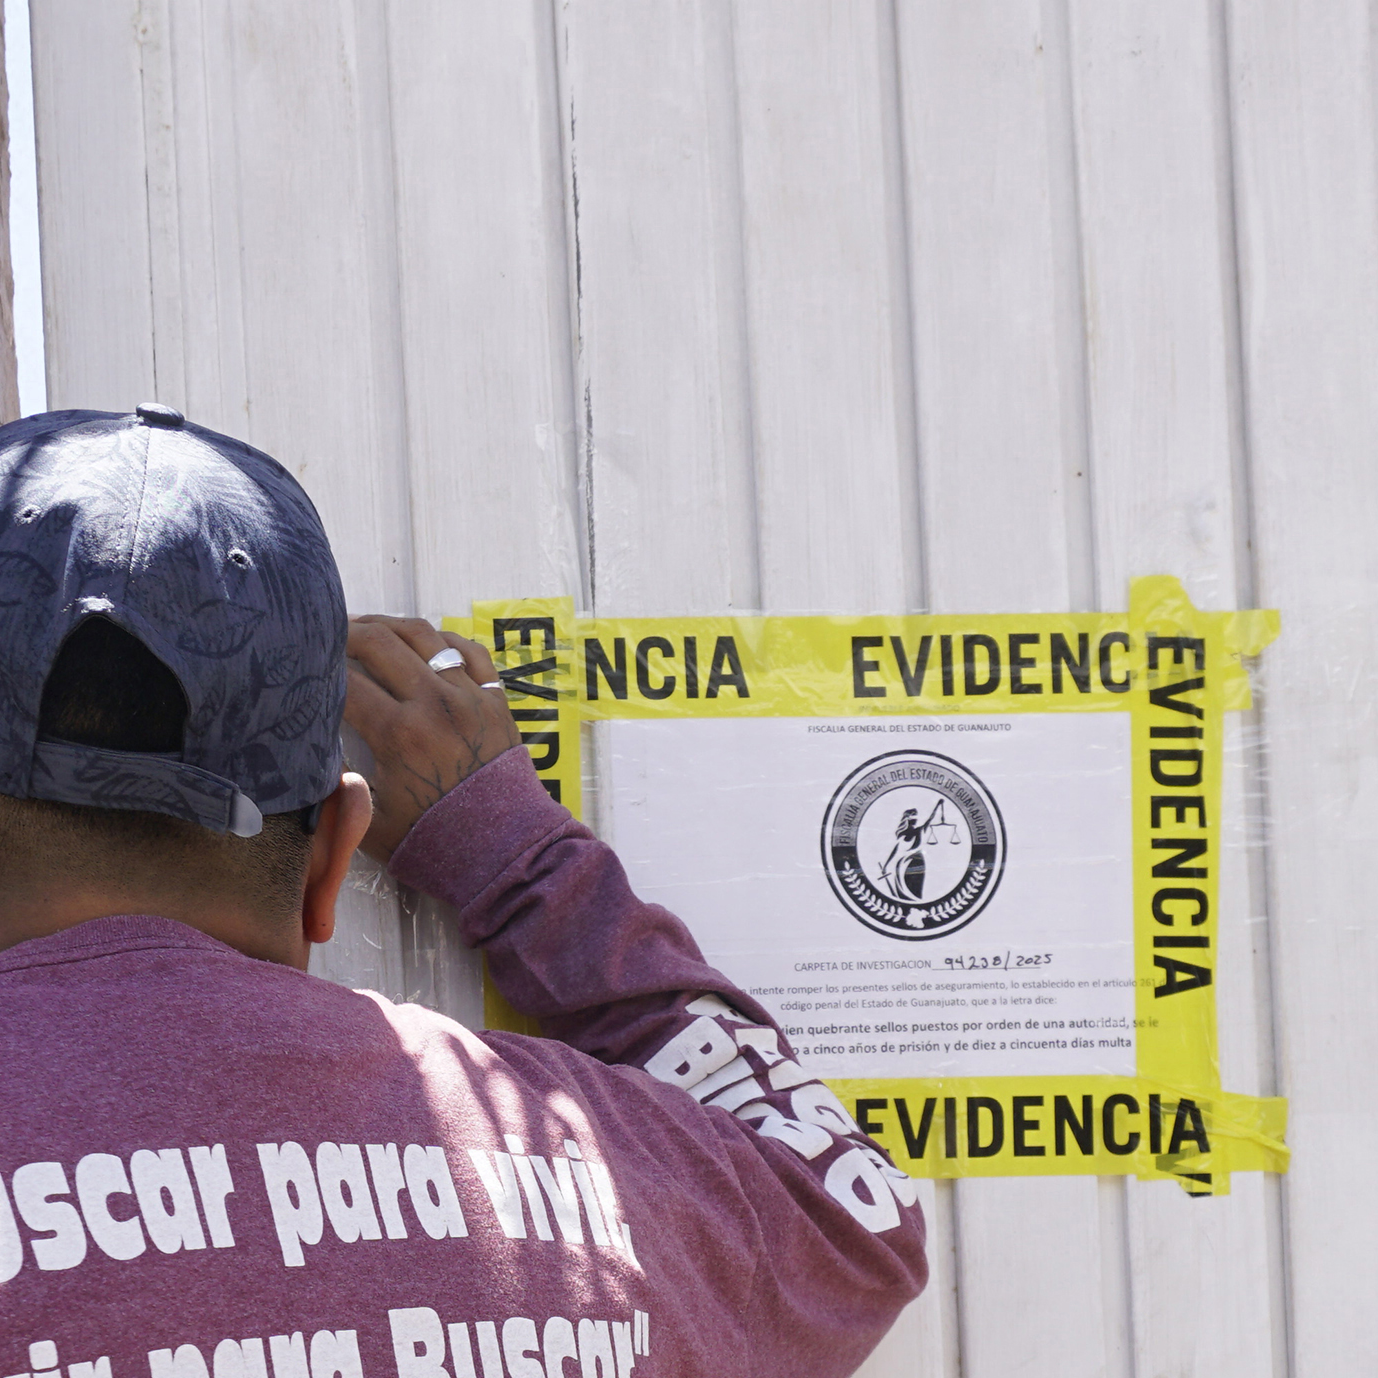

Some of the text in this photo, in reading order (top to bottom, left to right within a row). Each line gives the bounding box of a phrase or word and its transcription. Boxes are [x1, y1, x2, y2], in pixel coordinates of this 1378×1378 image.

[584, 630, 1132, 700] NCIA EVIDENC
[808, 723, 1012, 734] FISCALIA GENERAL DEL ESTADO DE GUANAJUTO
[839, 804, 859, 845] FISCALIA
[856, 775, 891, 809] GENERAL
[890, 768, 909, 785] DEL
[910, 768, 944, 785] ESTADO
[945, 778, 959, 793] DE
[1147, 634, 1213, 999] EVIDENCIA
[794, 960, 932, 972] CARPETA DE INVESTIGACION
[944, 950, 1053, 971] 94238/2025
[749, 986, 785, 995] intente
[787, 986, 823, 997] romper
[825, 984, 840, 993] los
[842, 984, 889, 996] presentes
[891, 982, 918, 992] sellos
[920, 982, 933, 992] de
[935, 979, 1009, 993] aseguramiento,
[1011, 980, 1020, 990] lo
[1022, 979, 1075, 990] establecido
[1078, 979, 1089, 989] en
[1092, 979, 1101, 988] el
[780, 995, 1057, 1012] código penal del Estado de Guanajuato, que la letra dice:
[782, 1025, 804, 1036] ien
[807, 1023, 871, 1039] quebrante
[874, 1021, 908, 1034] sellos
[911, 1021, 959, 1037] puestos
[962, 1020, 983, 1033] por
[986, 1018, 1021, 1031] orden
[1024, 1018, 1040, 1030] de
[1043, 1018, 1065, 1030] una
[1069, 1016, 1130, 1030] autoridad,
[1132, 1018, 1146, 1028] se
[813, 1036, 1132, 1056] cinco años de prisión de diez cincuenta días multa
[856, 1094, 1211, 1160] EVIDENCIA
[256, 1140, 468, 1268] para
